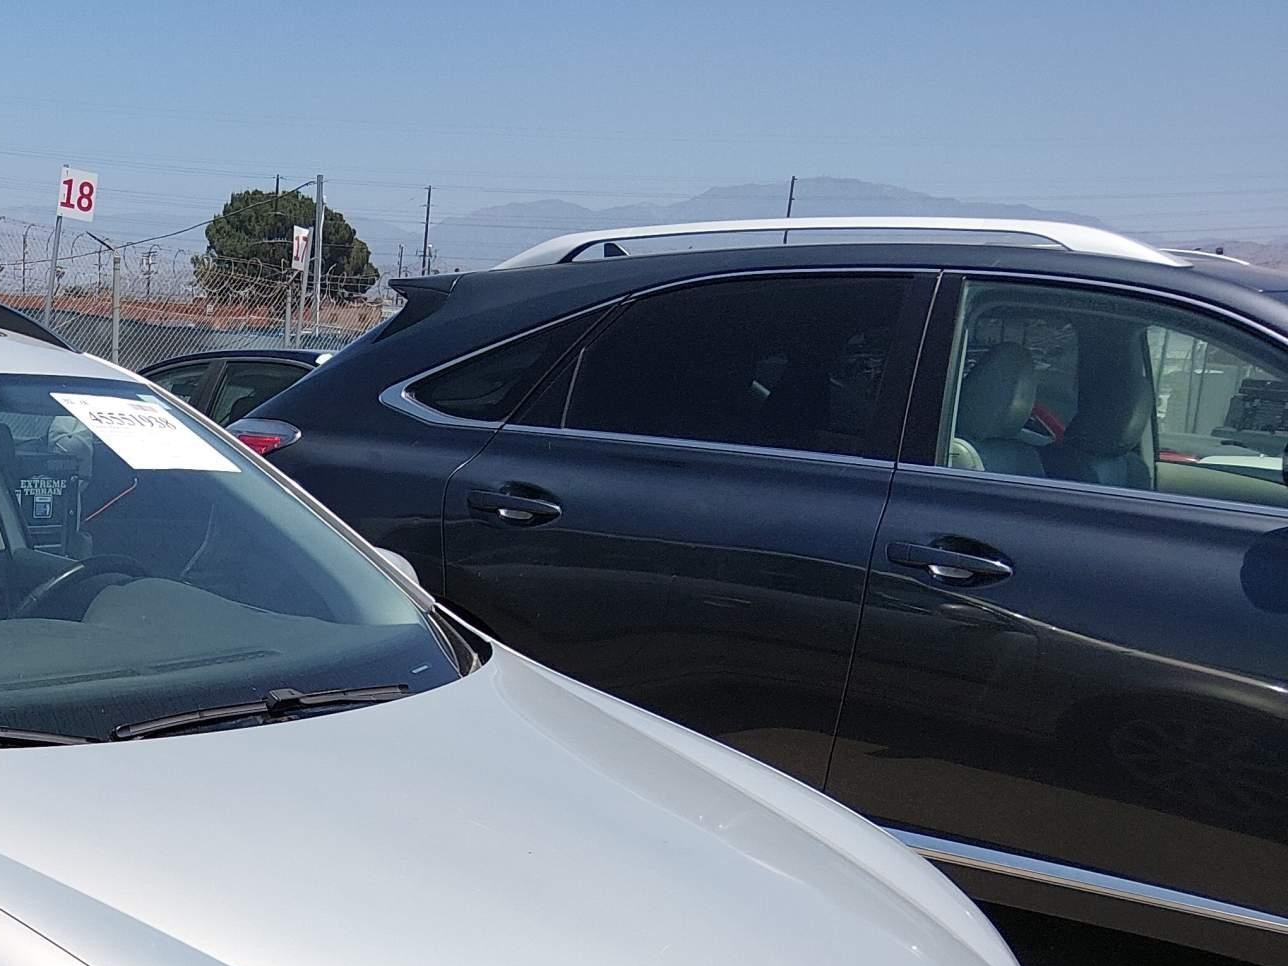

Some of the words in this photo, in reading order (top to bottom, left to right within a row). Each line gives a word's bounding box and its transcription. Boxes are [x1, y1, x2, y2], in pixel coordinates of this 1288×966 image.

[60, 178, 95, 212] 18
[293, 235, 310, 263] 17
[88, 411, 177, 431] 45551938
[20, 479, 67, 489] EXTREME
